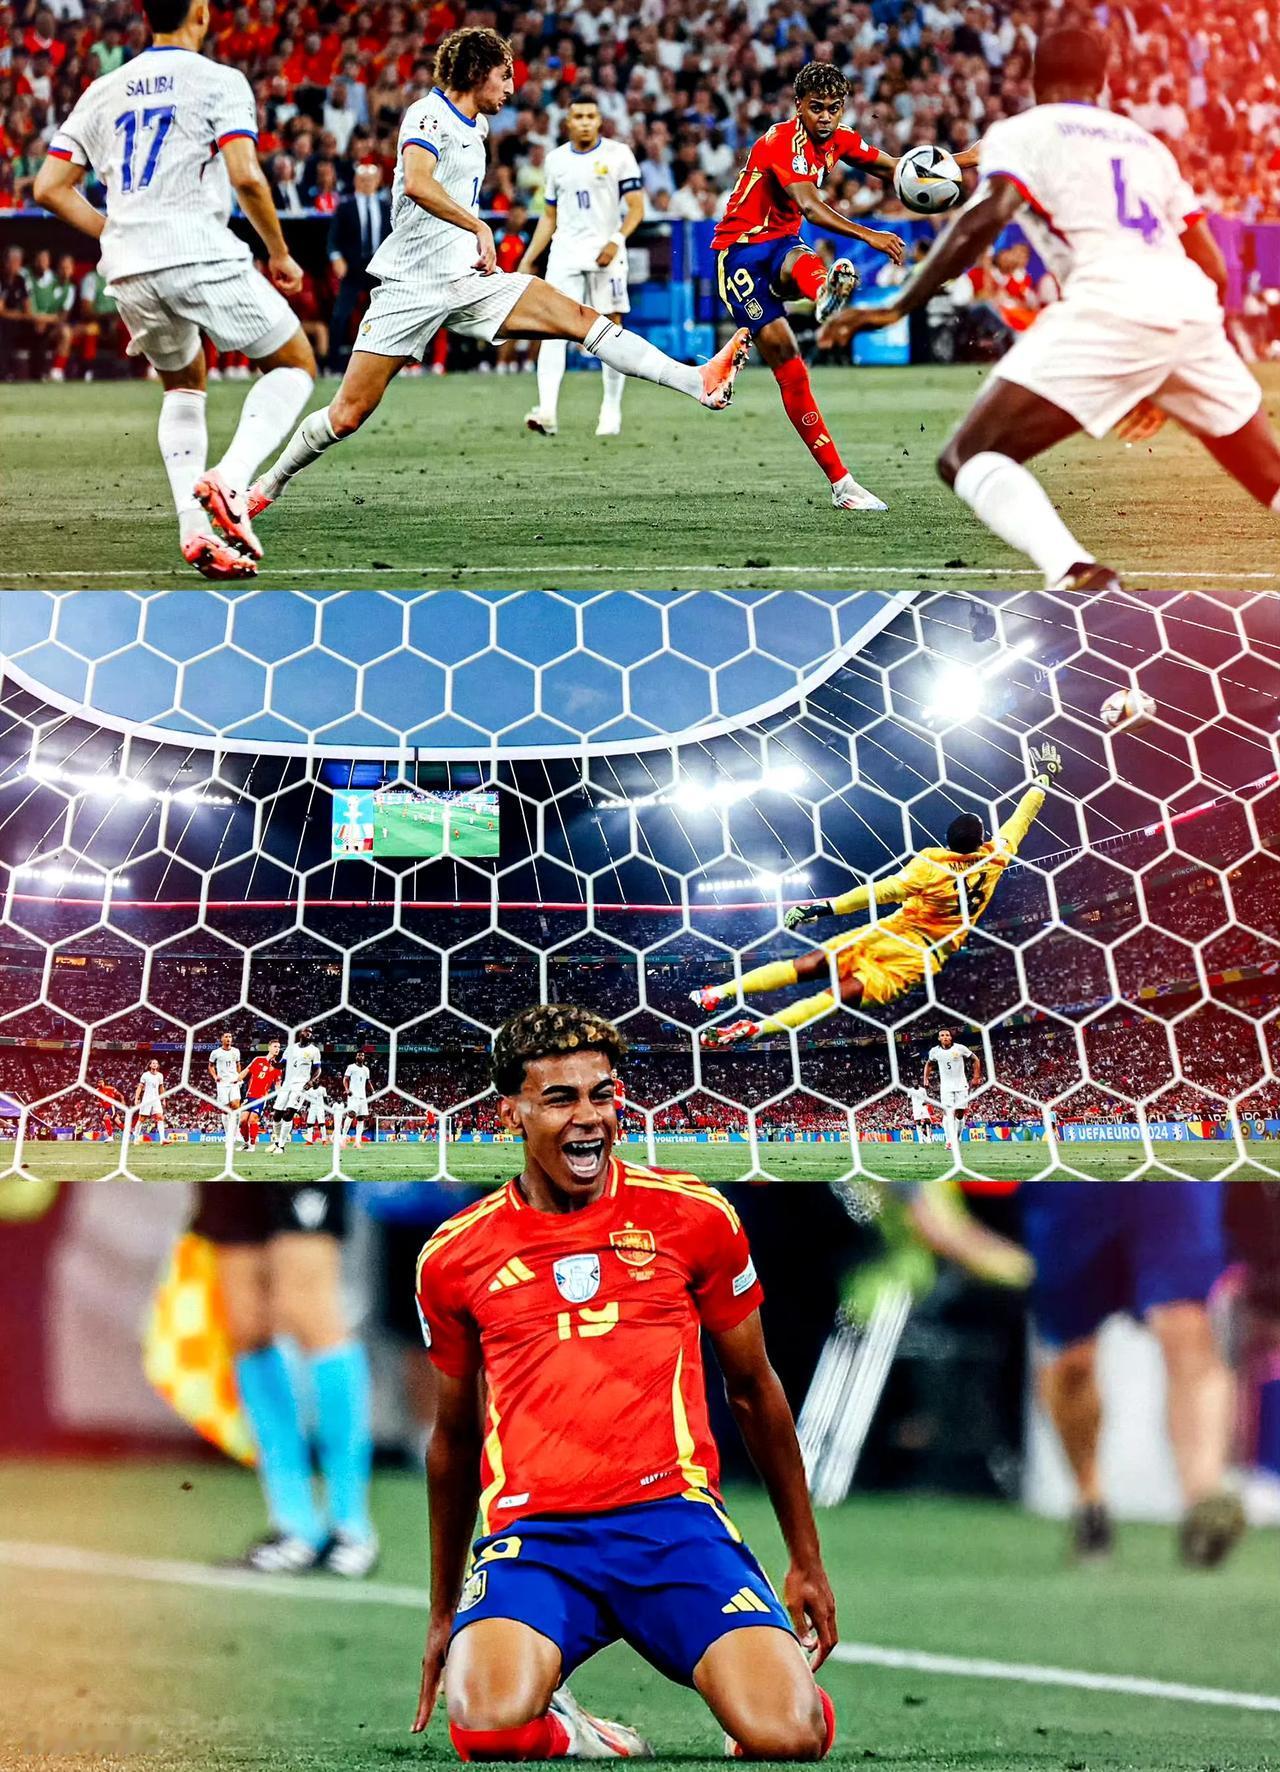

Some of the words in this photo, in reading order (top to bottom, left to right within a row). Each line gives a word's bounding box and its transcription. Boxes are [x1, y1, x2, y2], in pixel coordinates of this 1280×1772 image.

[114, 105, 176, 193] 17
[576, 190, 591, 210] 10
[1110, 157, 1158, 245] 4
[726, 268, 755, 302] 19
[946, 1061, 952, 1070] 5
[557, 1301, 619, 1341] 19
